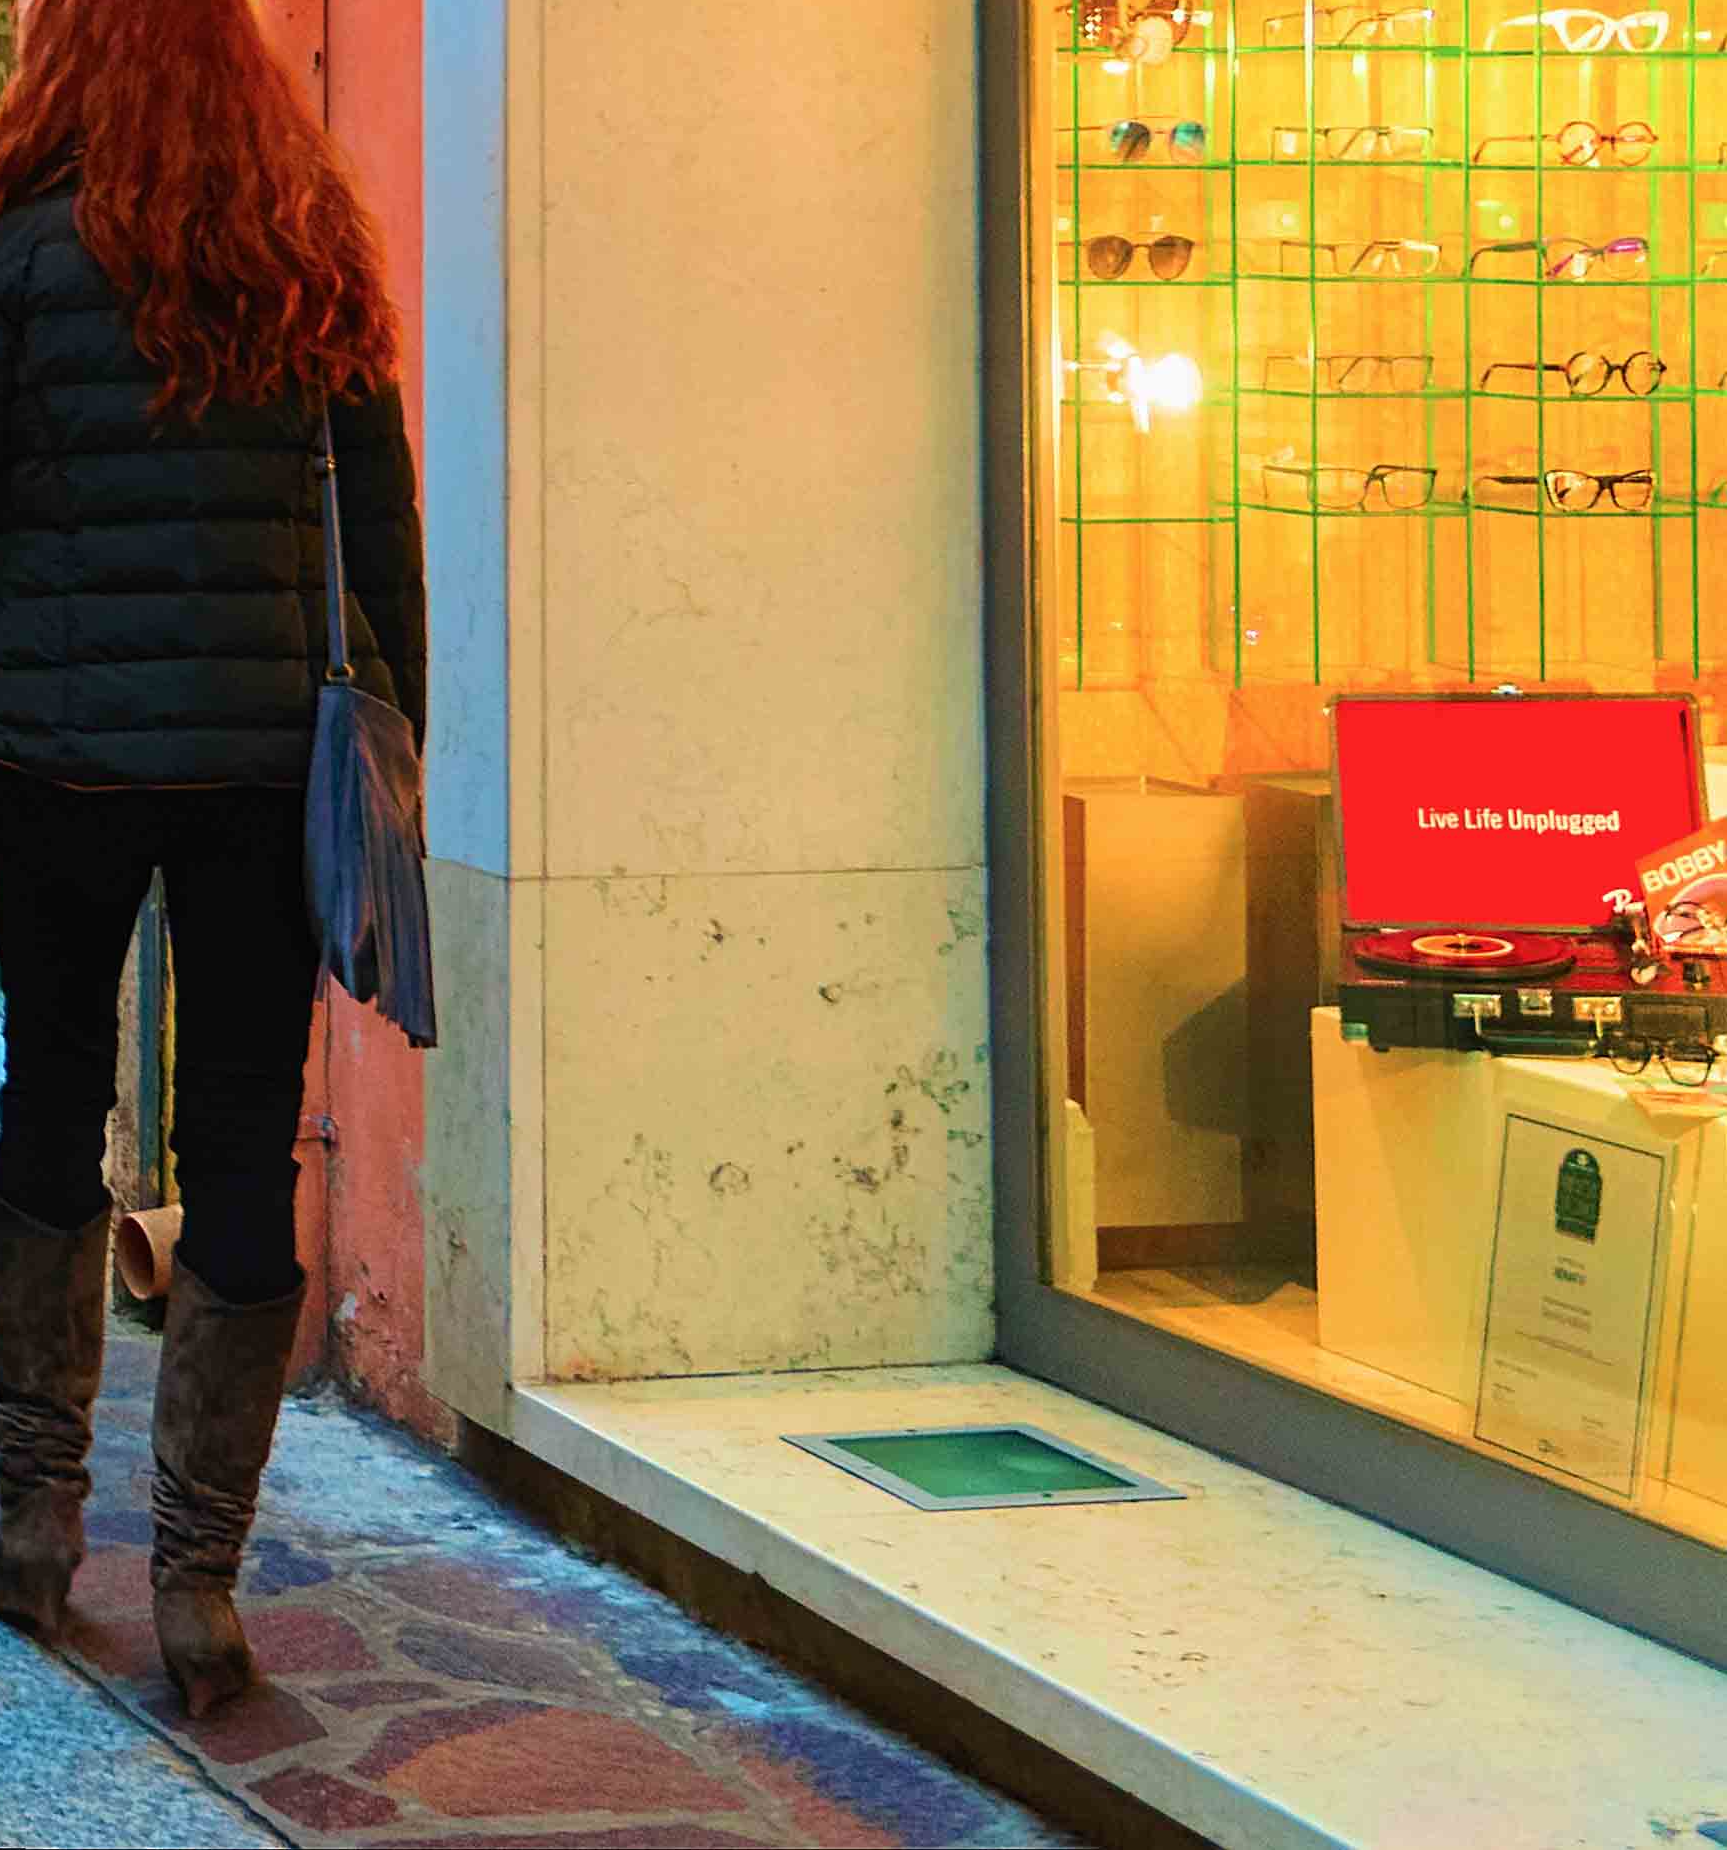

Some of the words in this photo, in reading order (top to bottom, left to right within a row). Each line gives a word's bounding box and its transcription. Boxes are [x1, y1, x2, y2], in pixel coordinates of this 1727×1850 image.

[1418, 807, 1459, 829] Live
[1464, 807, 1504, 830] Life
[1507, 808, 1620, 836] Unplugged
[1641, 838, 1726, 893] BOBBY
